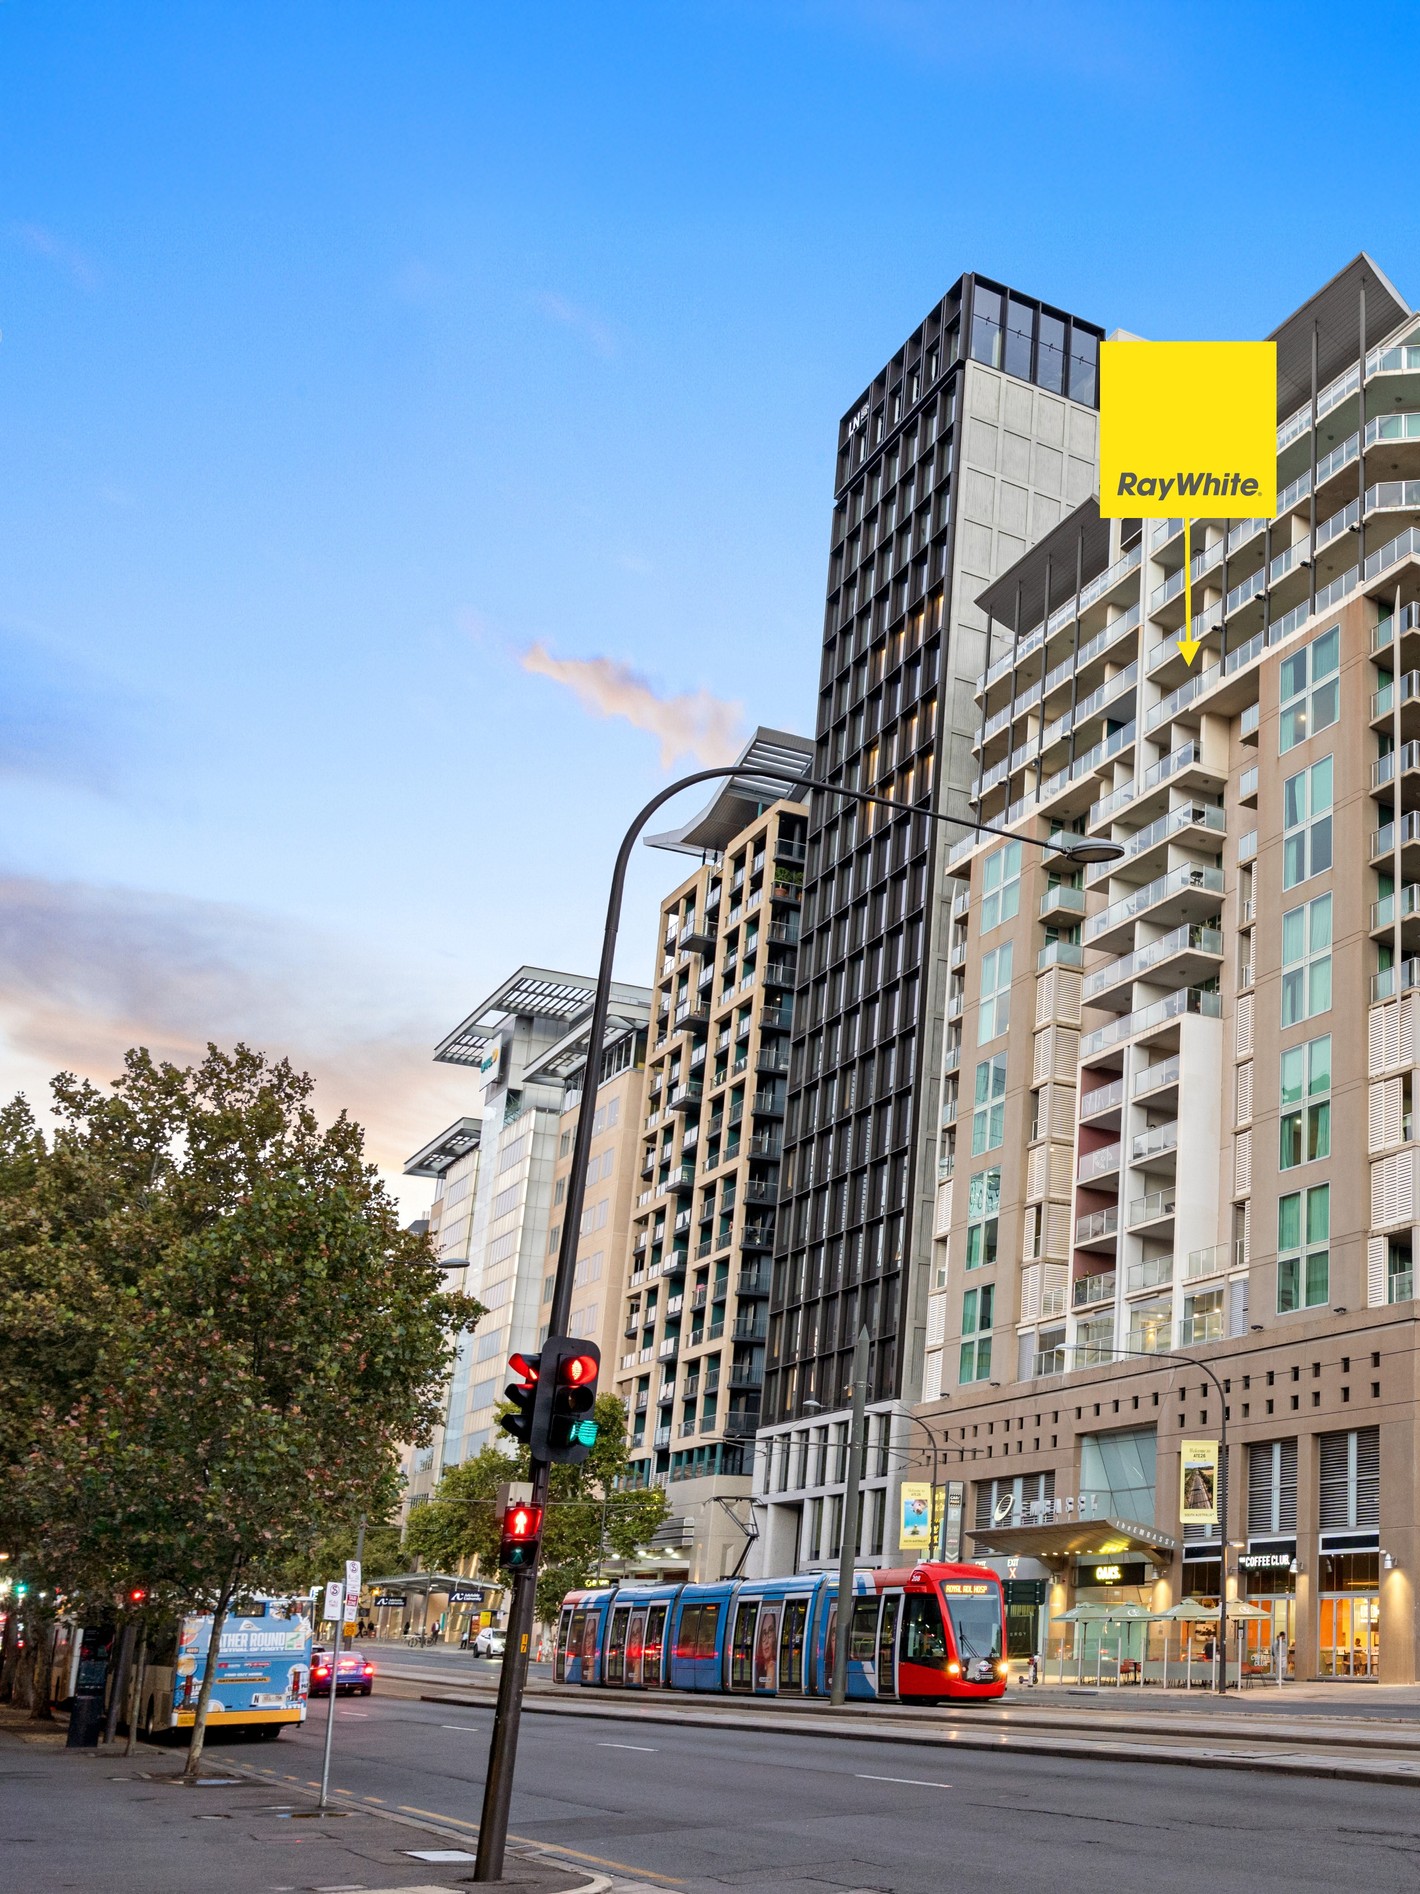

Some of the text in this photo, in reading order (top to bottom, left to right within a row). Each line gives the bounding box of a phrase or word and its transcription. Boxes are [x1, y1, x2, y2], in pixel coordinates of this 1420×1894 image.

[1007, 1558, 1019, 1567] EXIT
[1245, 1555, 1271, 1567] COFFEE
[945, 1584, 962, 1593] ROYAL
[973, 1584, 988, 1593] HOSP
[250, 1632, 286, 1647] ROUND
